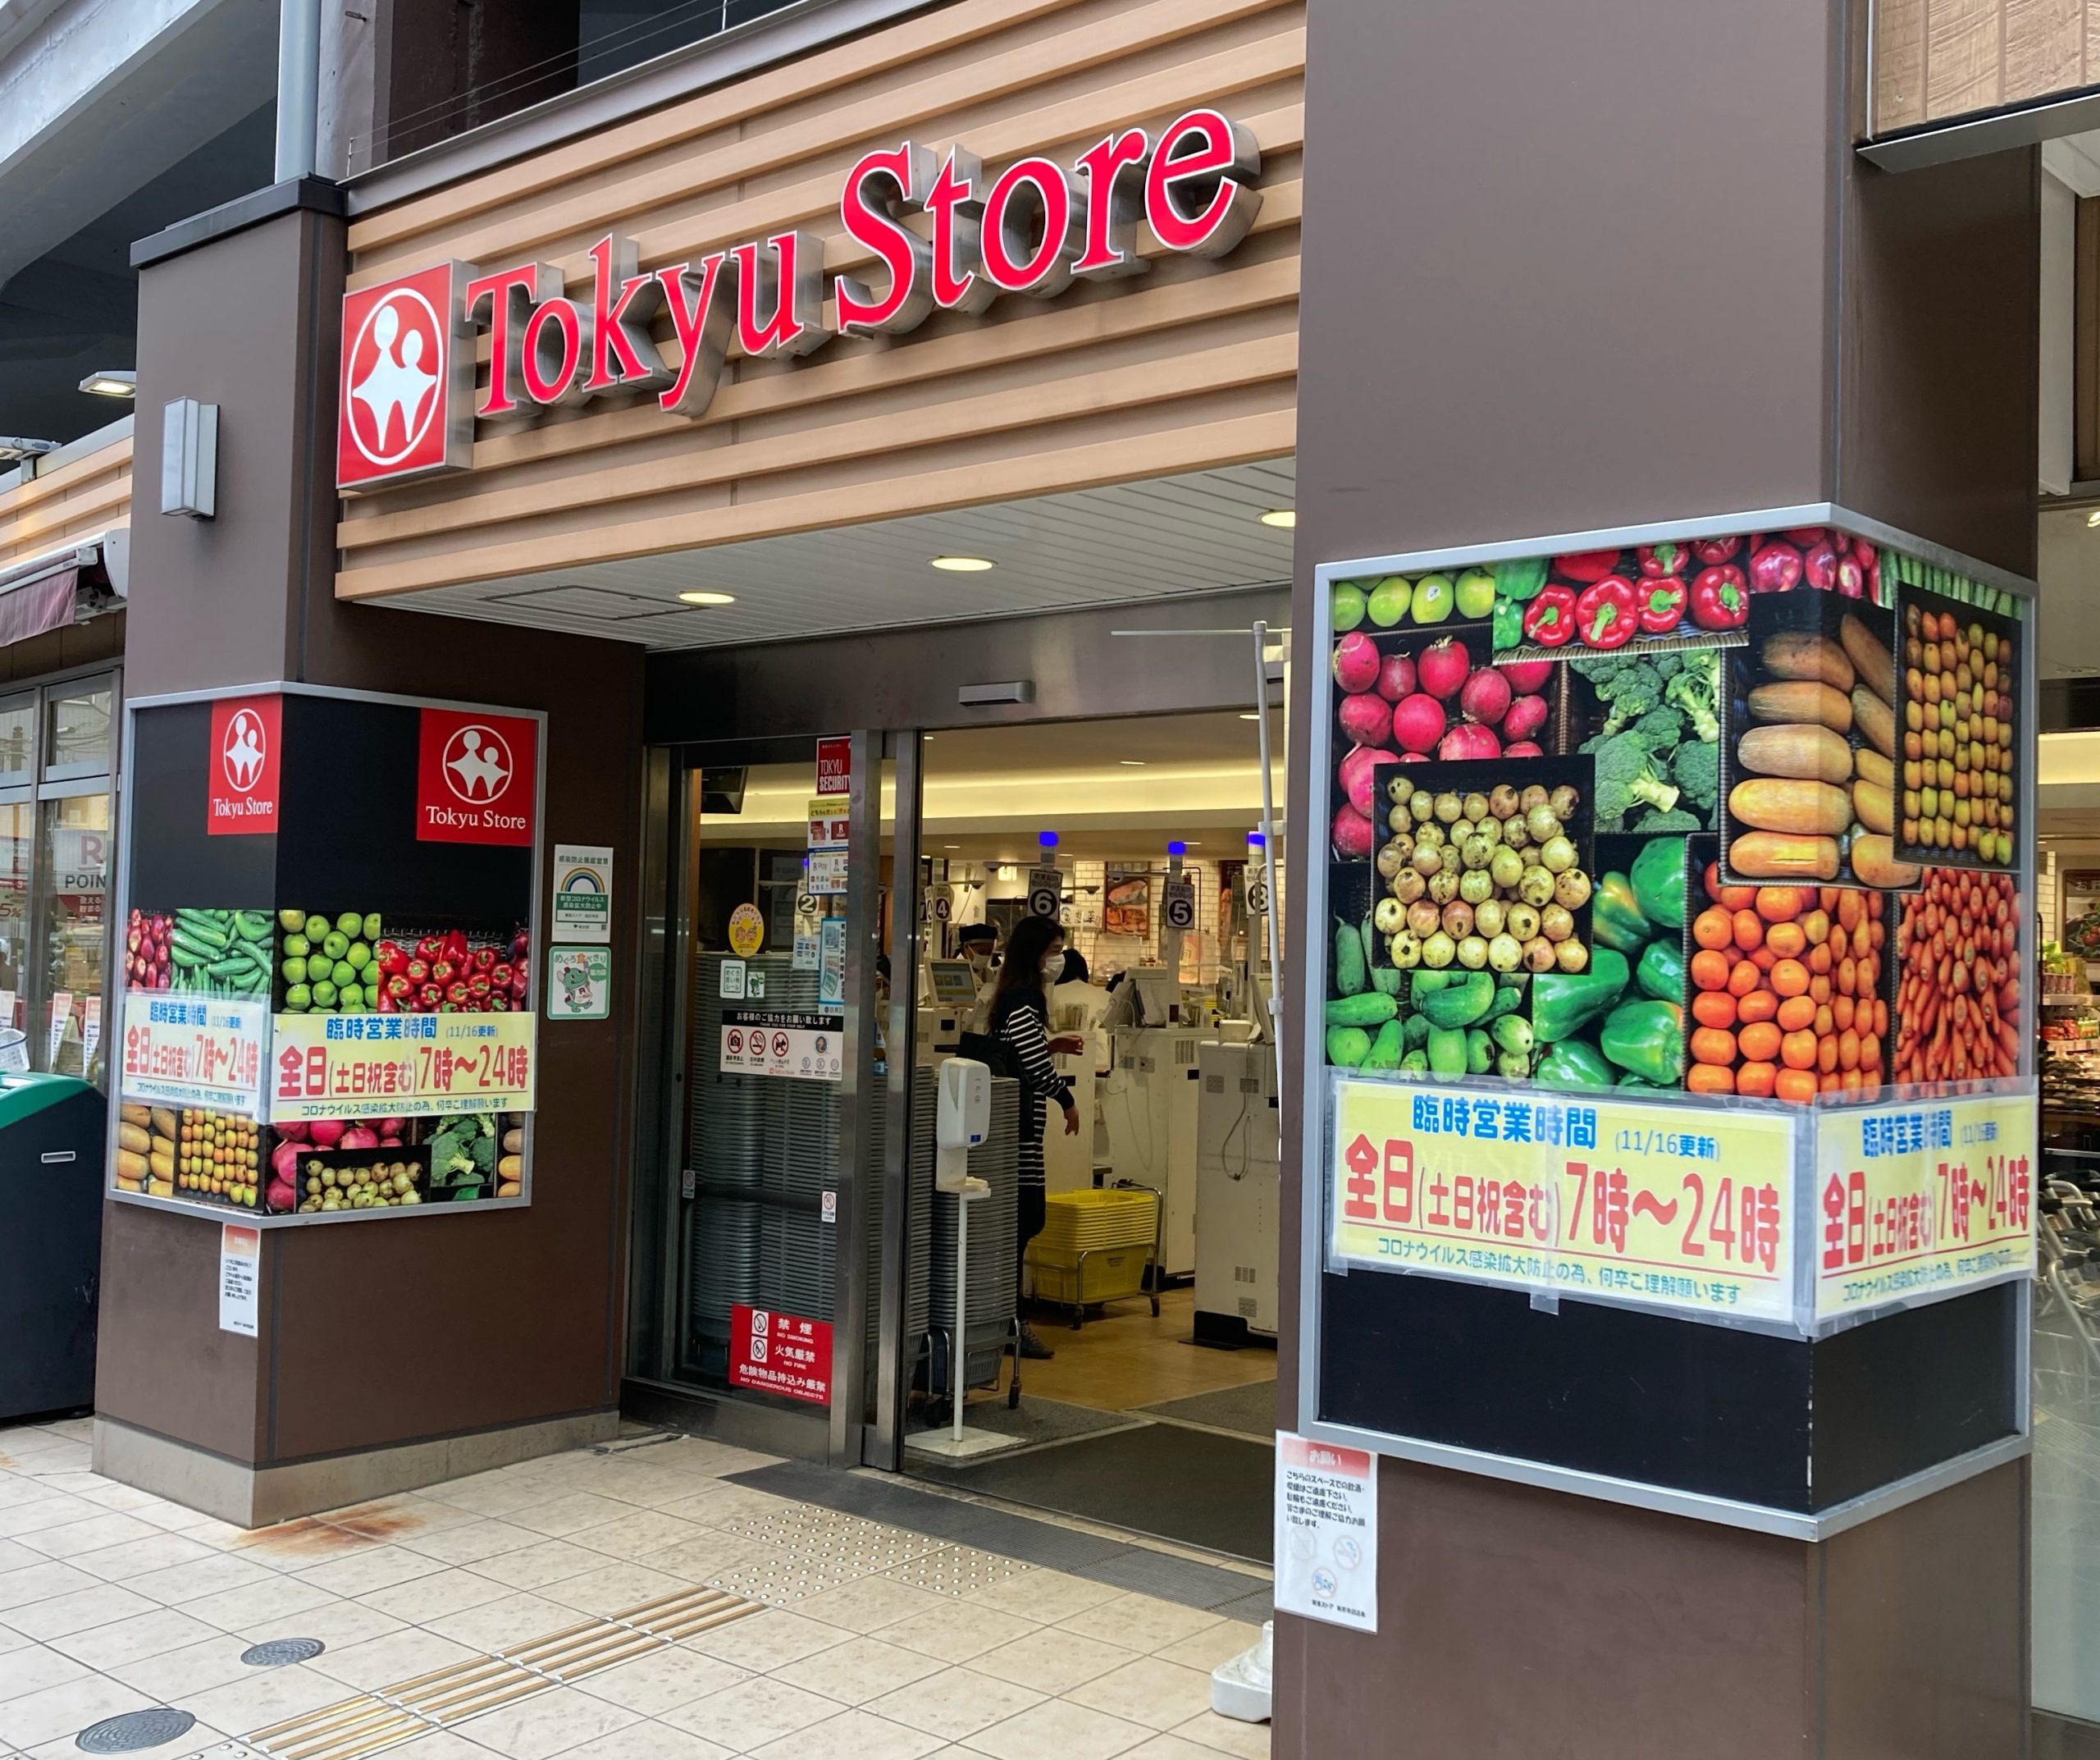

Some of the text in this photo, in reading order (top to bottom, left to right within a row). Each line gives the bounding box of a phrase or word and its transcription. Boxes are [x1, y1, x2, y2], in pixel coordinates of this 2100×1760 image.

[465, 108, 1237, 415] Tokyu Store
[820, 759, 842, 775] TOKYU
[213, 797, 273, 816] Tokyu Store
[426, 805, 527, 830] Tokyu Store
[80, 835, 104, 865] R
[800, 894, 815, 912] 2
[938, 900, 947, 917] 4
[1034, 891, 1052, 911] 6
[1173, 903, 1189, 925] 5
[150, 1001, 207, 1026] 臨時営業時間
[326, 1017, 498, 1040] 臨時営業時間 (11/16更新)
[1413, 1095, 1721, 1162] 臨時営業時間 (11/16更新)
[1862, 1109, 1952, 1158] 臨時営業時間
[774, 1344, 815, 1363] 火気厳禁
